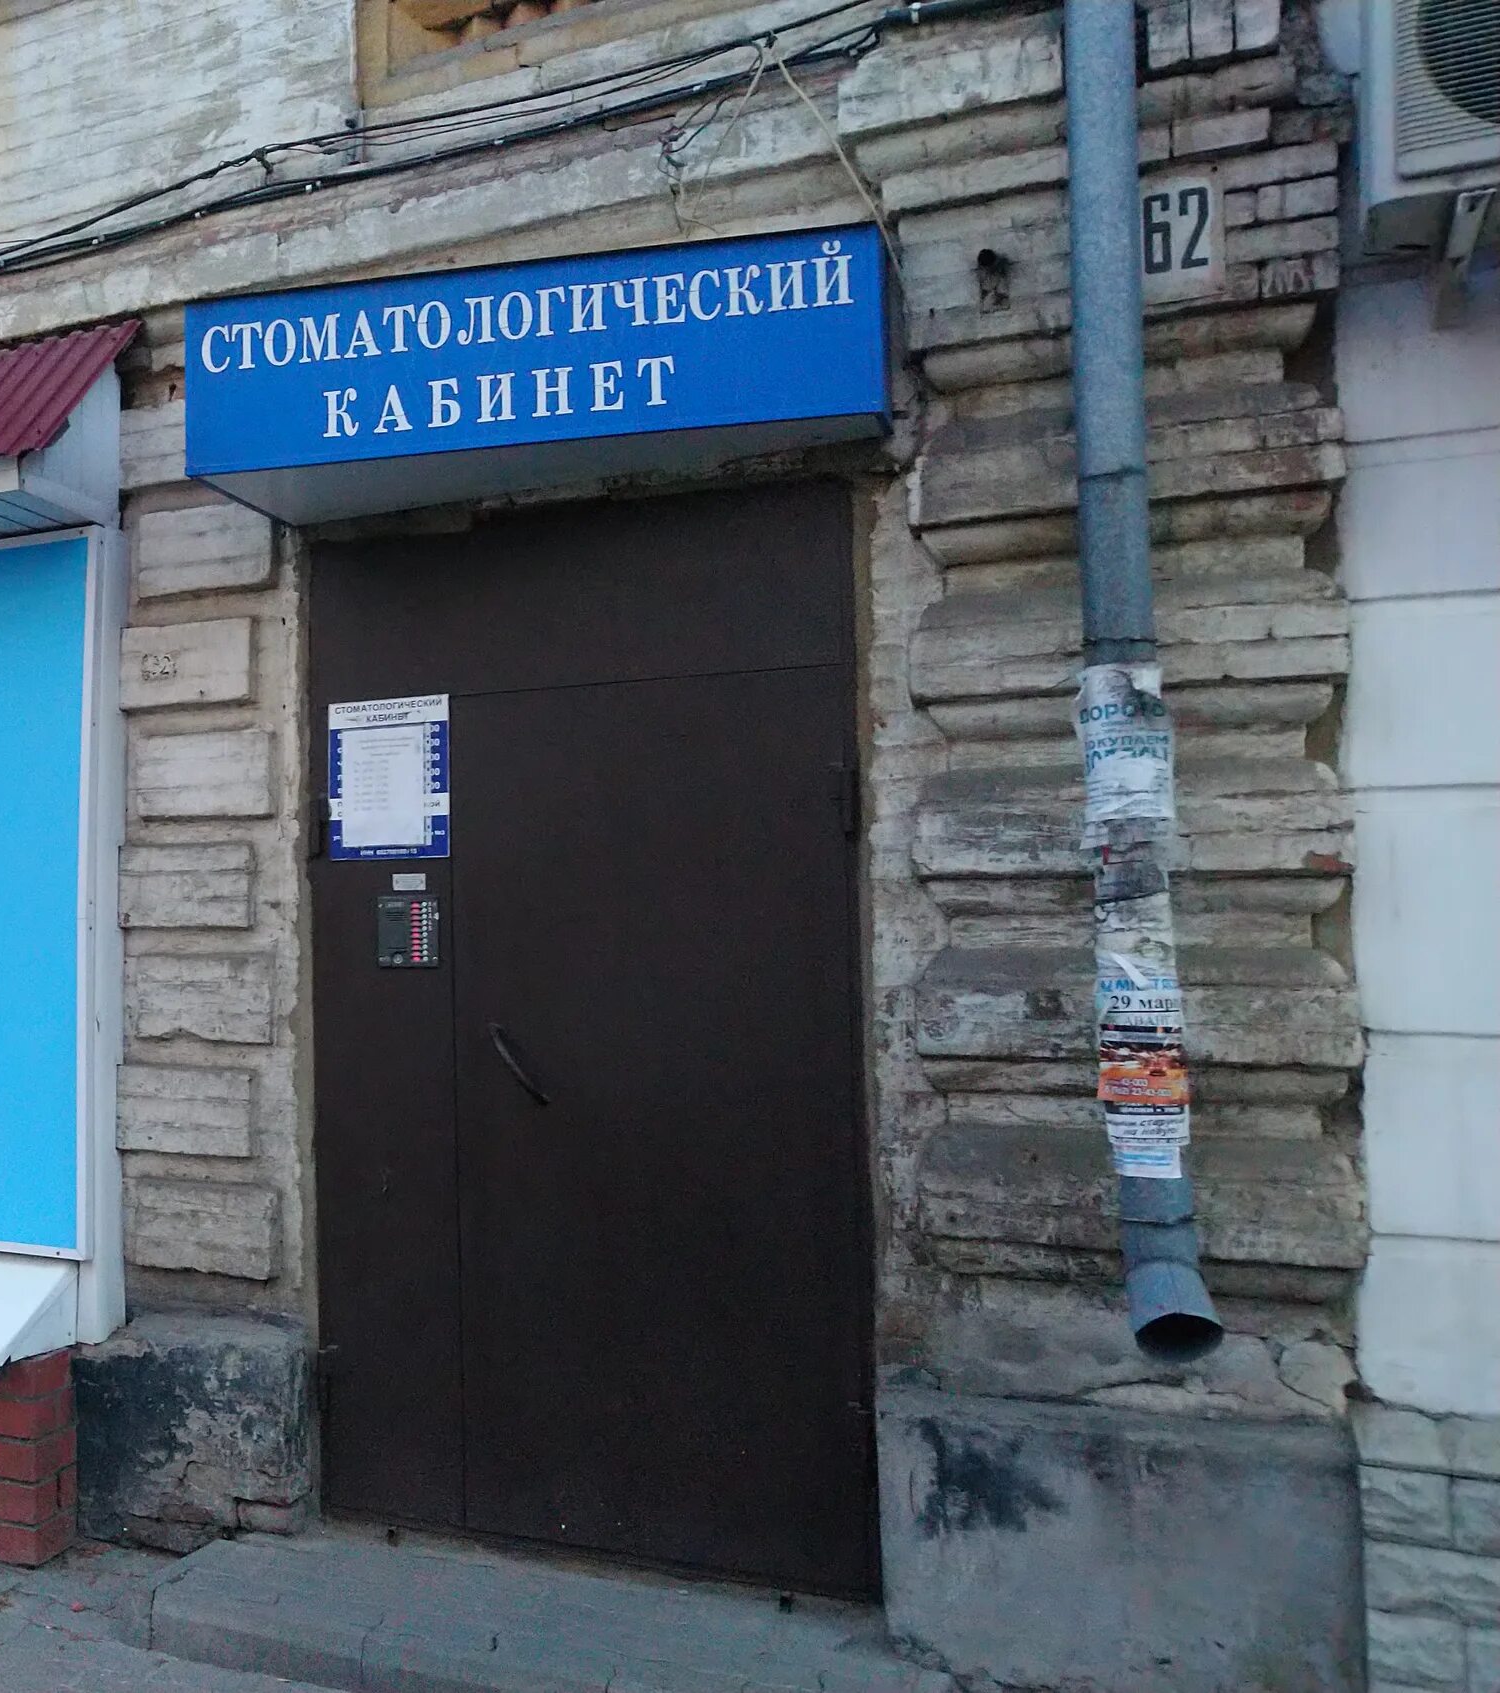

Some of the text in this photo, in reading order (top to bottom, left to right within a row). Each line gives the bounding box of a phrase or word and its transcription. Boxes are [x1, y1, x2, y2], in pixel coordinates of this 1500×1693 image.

[1142, 186, 1209, 274] 62
[201, 240, 854, 374] СТОМАТОЛОГИЧЕСКИЙ
[322, 355, 675, 438] КАБИНЕТ
[334, 698, 442, 715] СТОМАТОЛОГИЧЕСКИЙ
[366, 711, 409, 723] КАБИНЕТ
[1110, 995, 1131, 1010] 29
